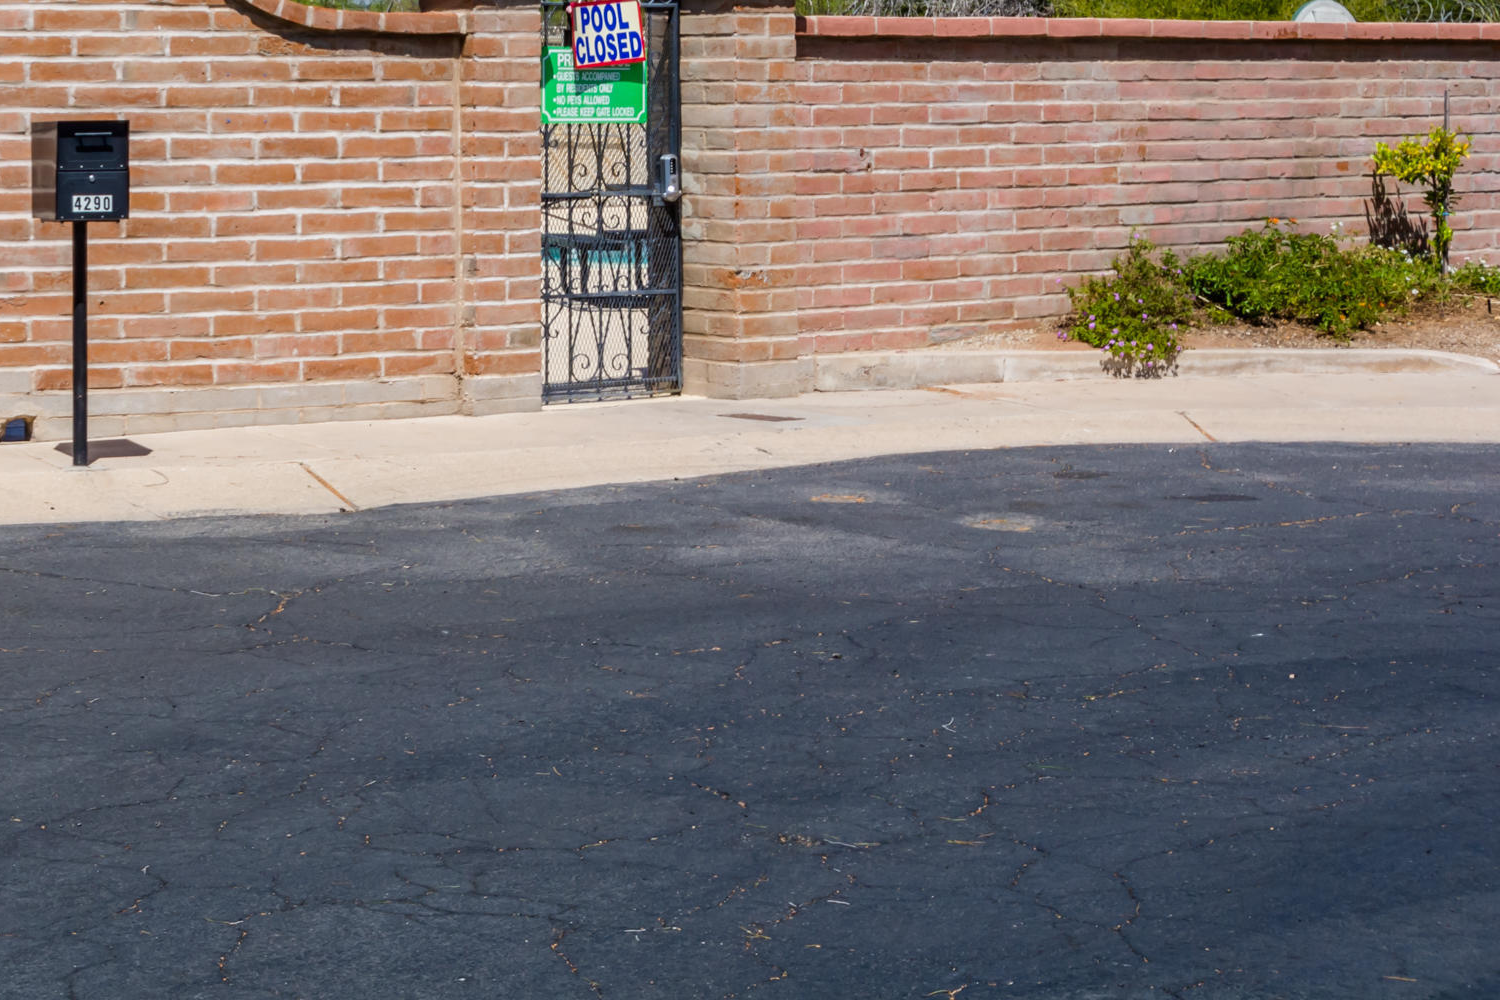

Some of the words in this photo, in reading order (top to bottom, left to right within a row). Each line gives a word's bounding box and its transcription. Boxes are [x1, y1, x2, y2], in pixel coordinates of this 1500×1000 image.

[580, 3, 629, 34] POOL
[576, 31, 642, 64] CLOSED
[556, 72, 579, 81] GUESTS
[556, 83, 564, 93] BY
[566, 83, 597, 93] RESIDENTS
[599, 83, 613, 93] ONLY
[556, 95, 566, 105] NO
[567, 95, 581, 105] PETS
[583, 95, 610, 105] ALLOWED
[556, 107, 579, 117] PLEASE
[580, 107, 595, 117] KEEP
[596, 107, 610, 117] GATE
[611, 107, 635, 117] LOCKED
[74, 196, 111, 211] 4290
